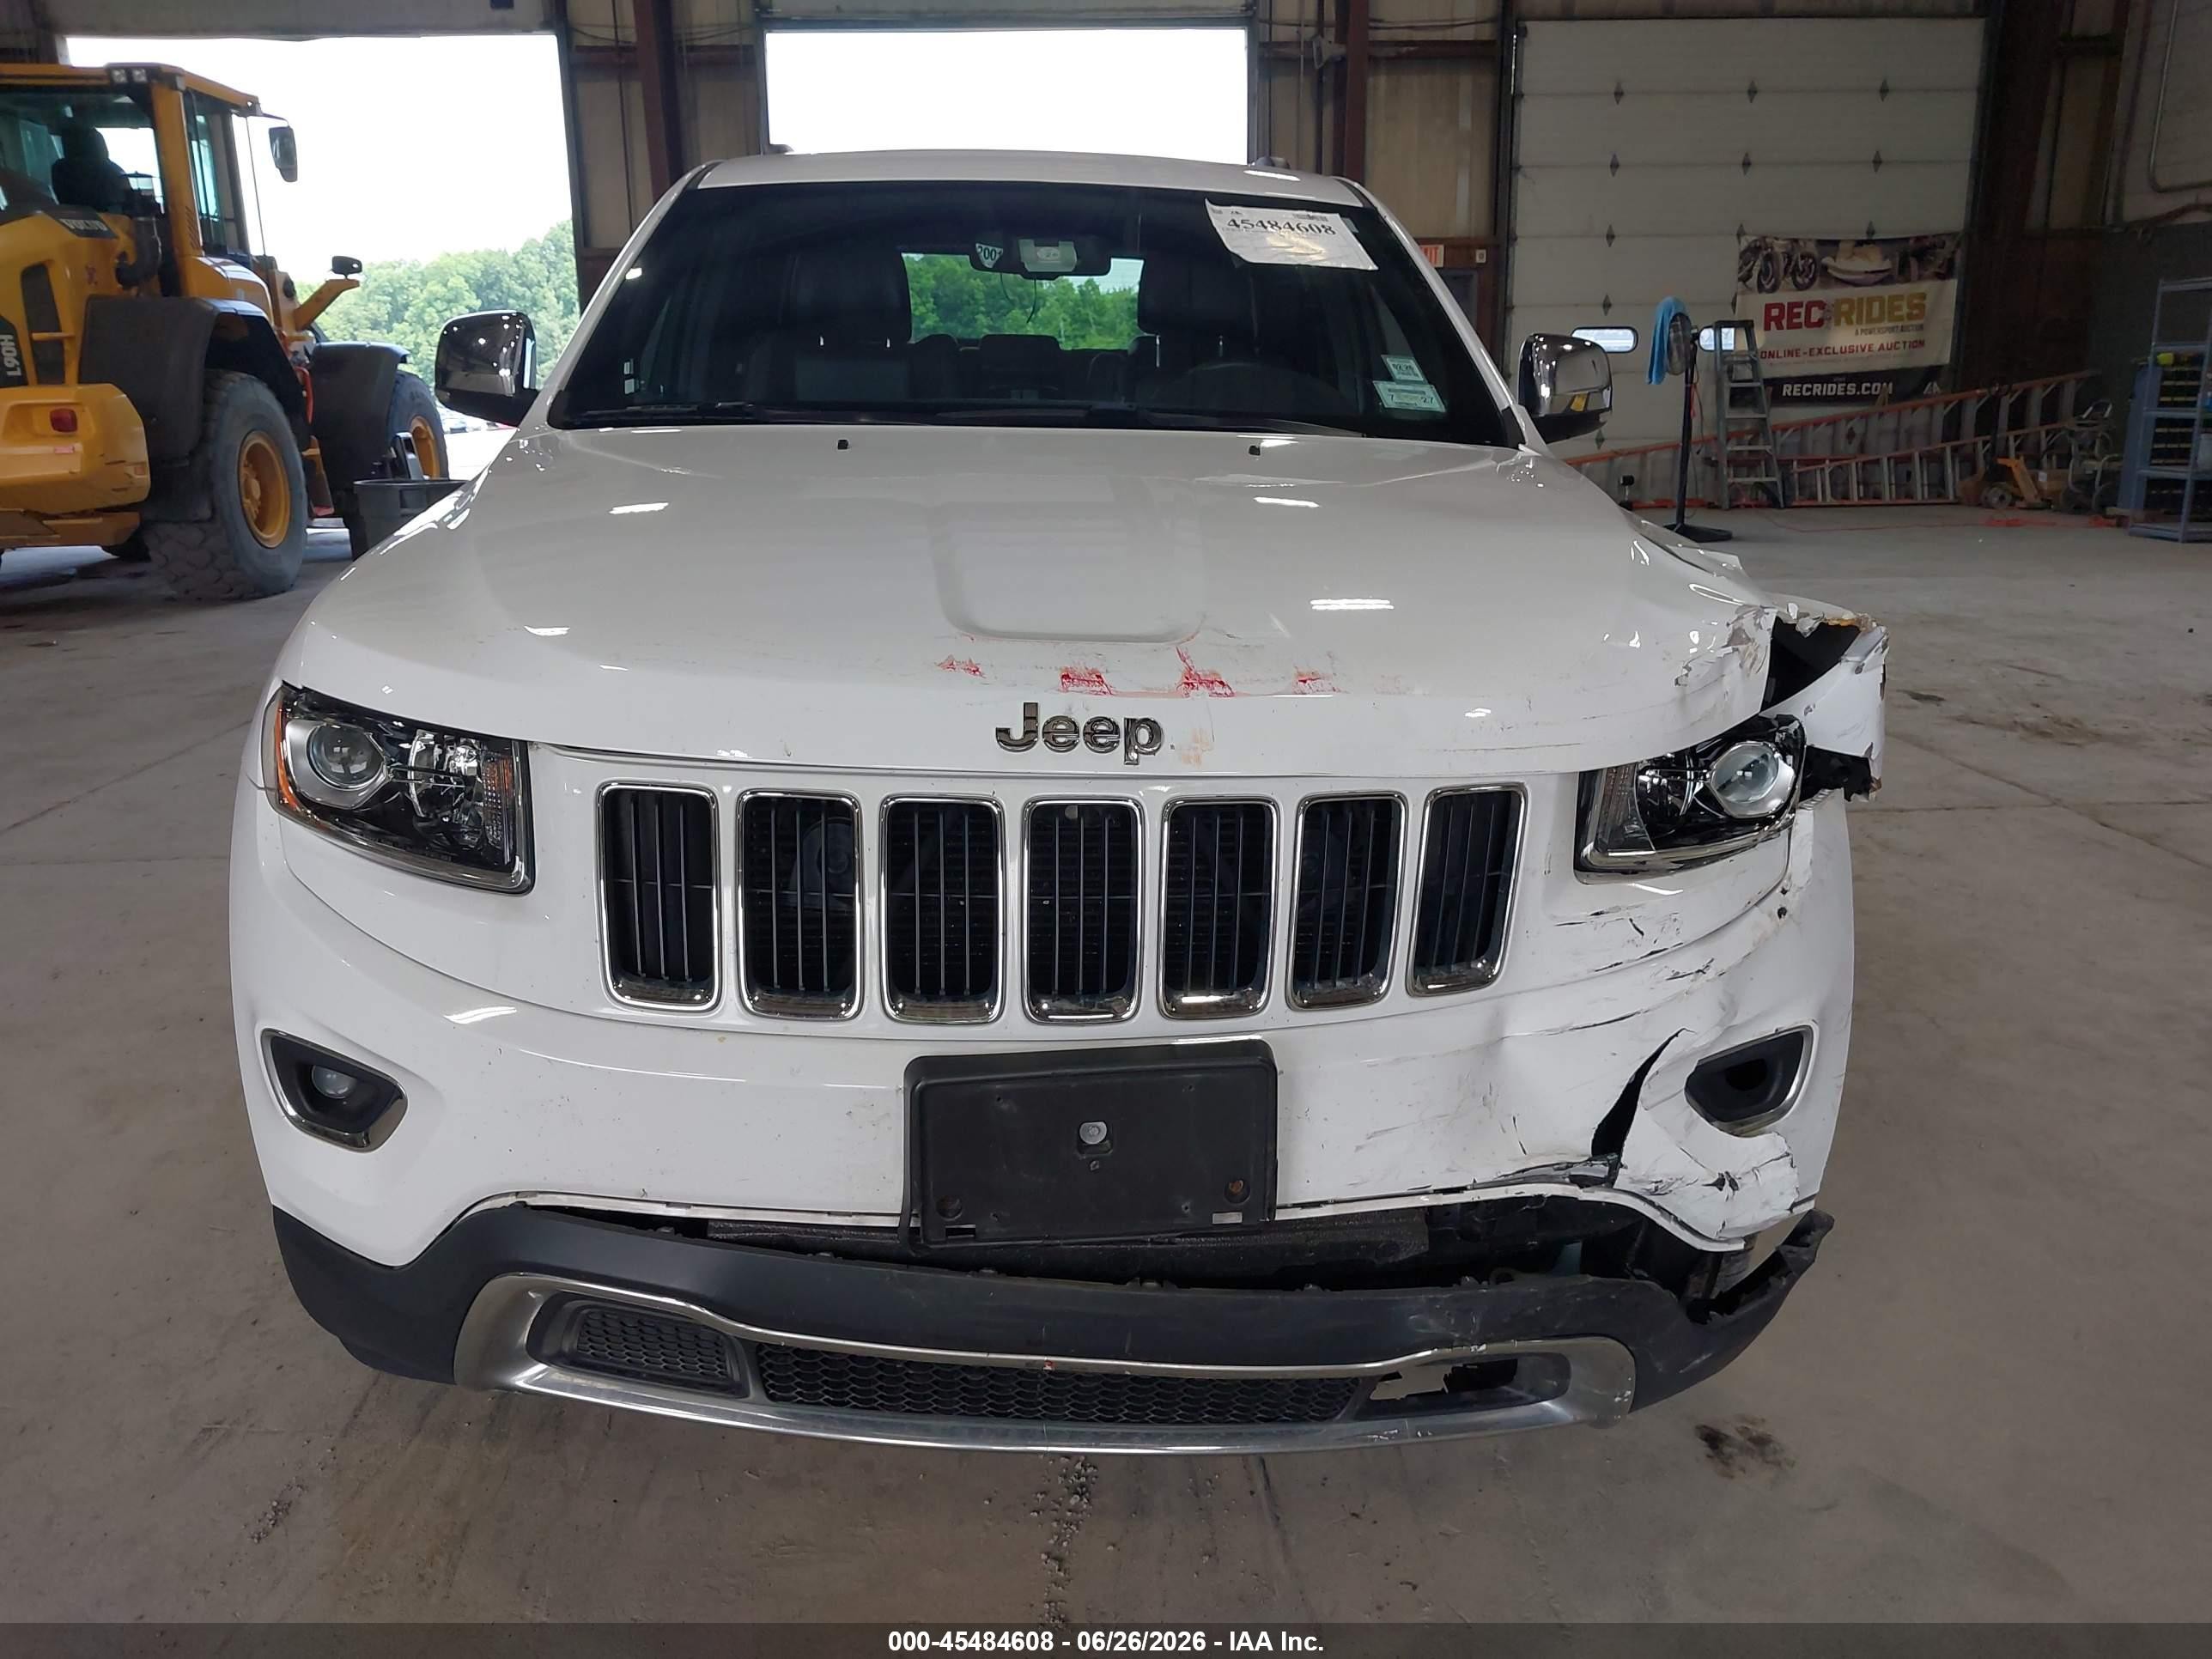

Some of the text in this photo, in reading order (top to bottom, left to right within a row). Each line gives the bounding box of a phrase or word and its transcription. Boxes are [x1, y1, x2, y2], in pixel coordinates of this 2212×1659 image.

[1227, 218, 1336, 235] 45484608
[1764, 292, 1927, 331] REC RIDES
[0, 334, 21, 376] L90H
[1760, 343, 1874, 359] ONLINE-EXCLUSIVE
[1878, 339, 1925, 351] AUCTION
[996, 702, 1165, 765] Jeep
